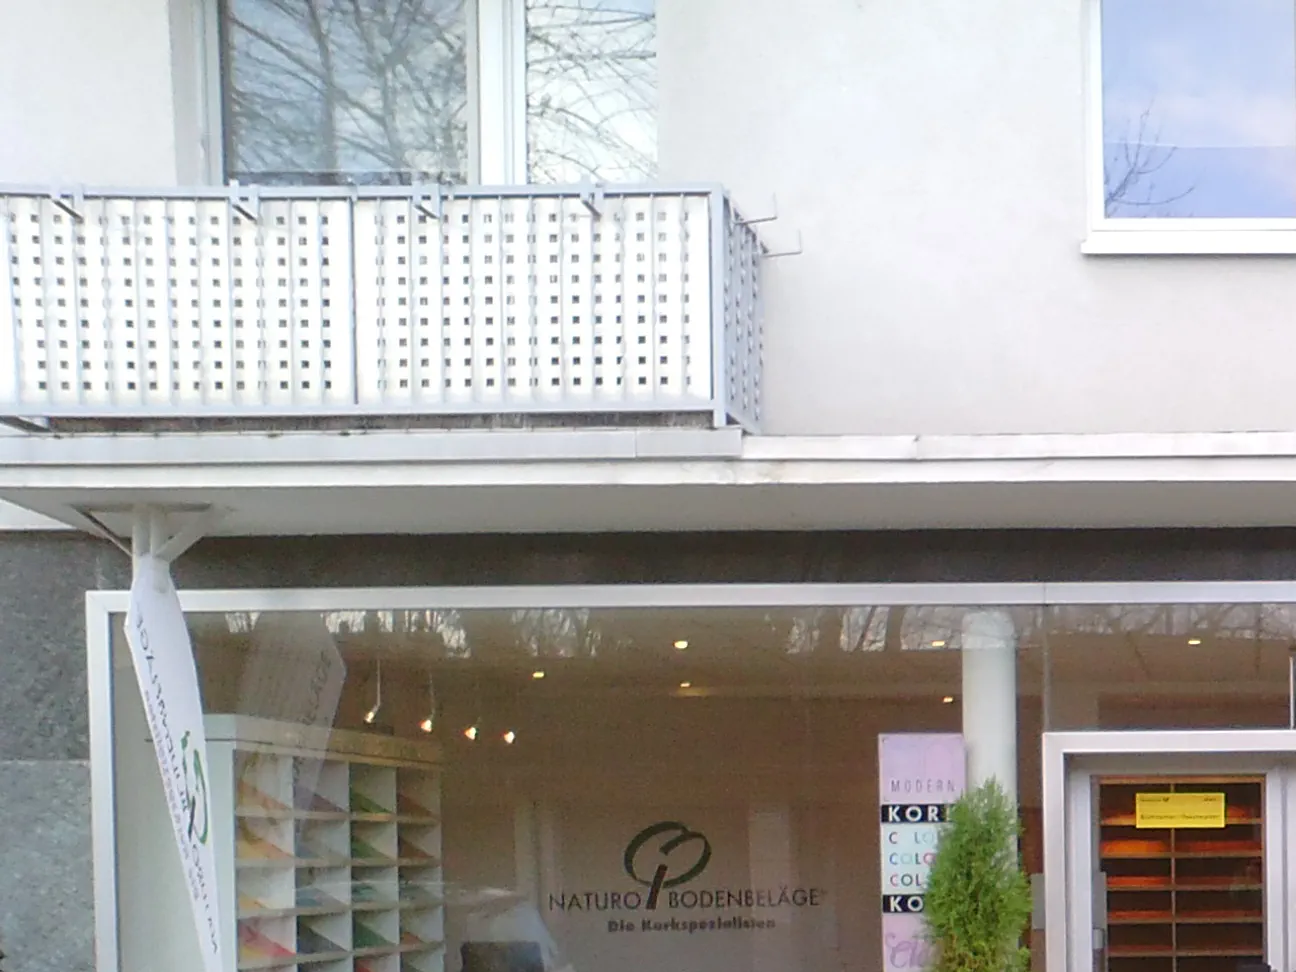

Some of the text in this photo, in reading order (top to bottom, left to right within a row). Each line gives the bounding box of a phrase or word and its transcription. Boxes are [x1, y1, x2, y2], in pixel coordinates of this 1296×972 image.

[890, 779, 956, 794] MODERN
[888, 805, 949, 822] KOR
[889, 852, 937, 866] COLO
[890, 873, 922, 887] COL
[549, 886, 821, 911] NATURO BODENBELÄGE
[890, 895, 925, 912] KO
[607, 919, 635, 933] Die
